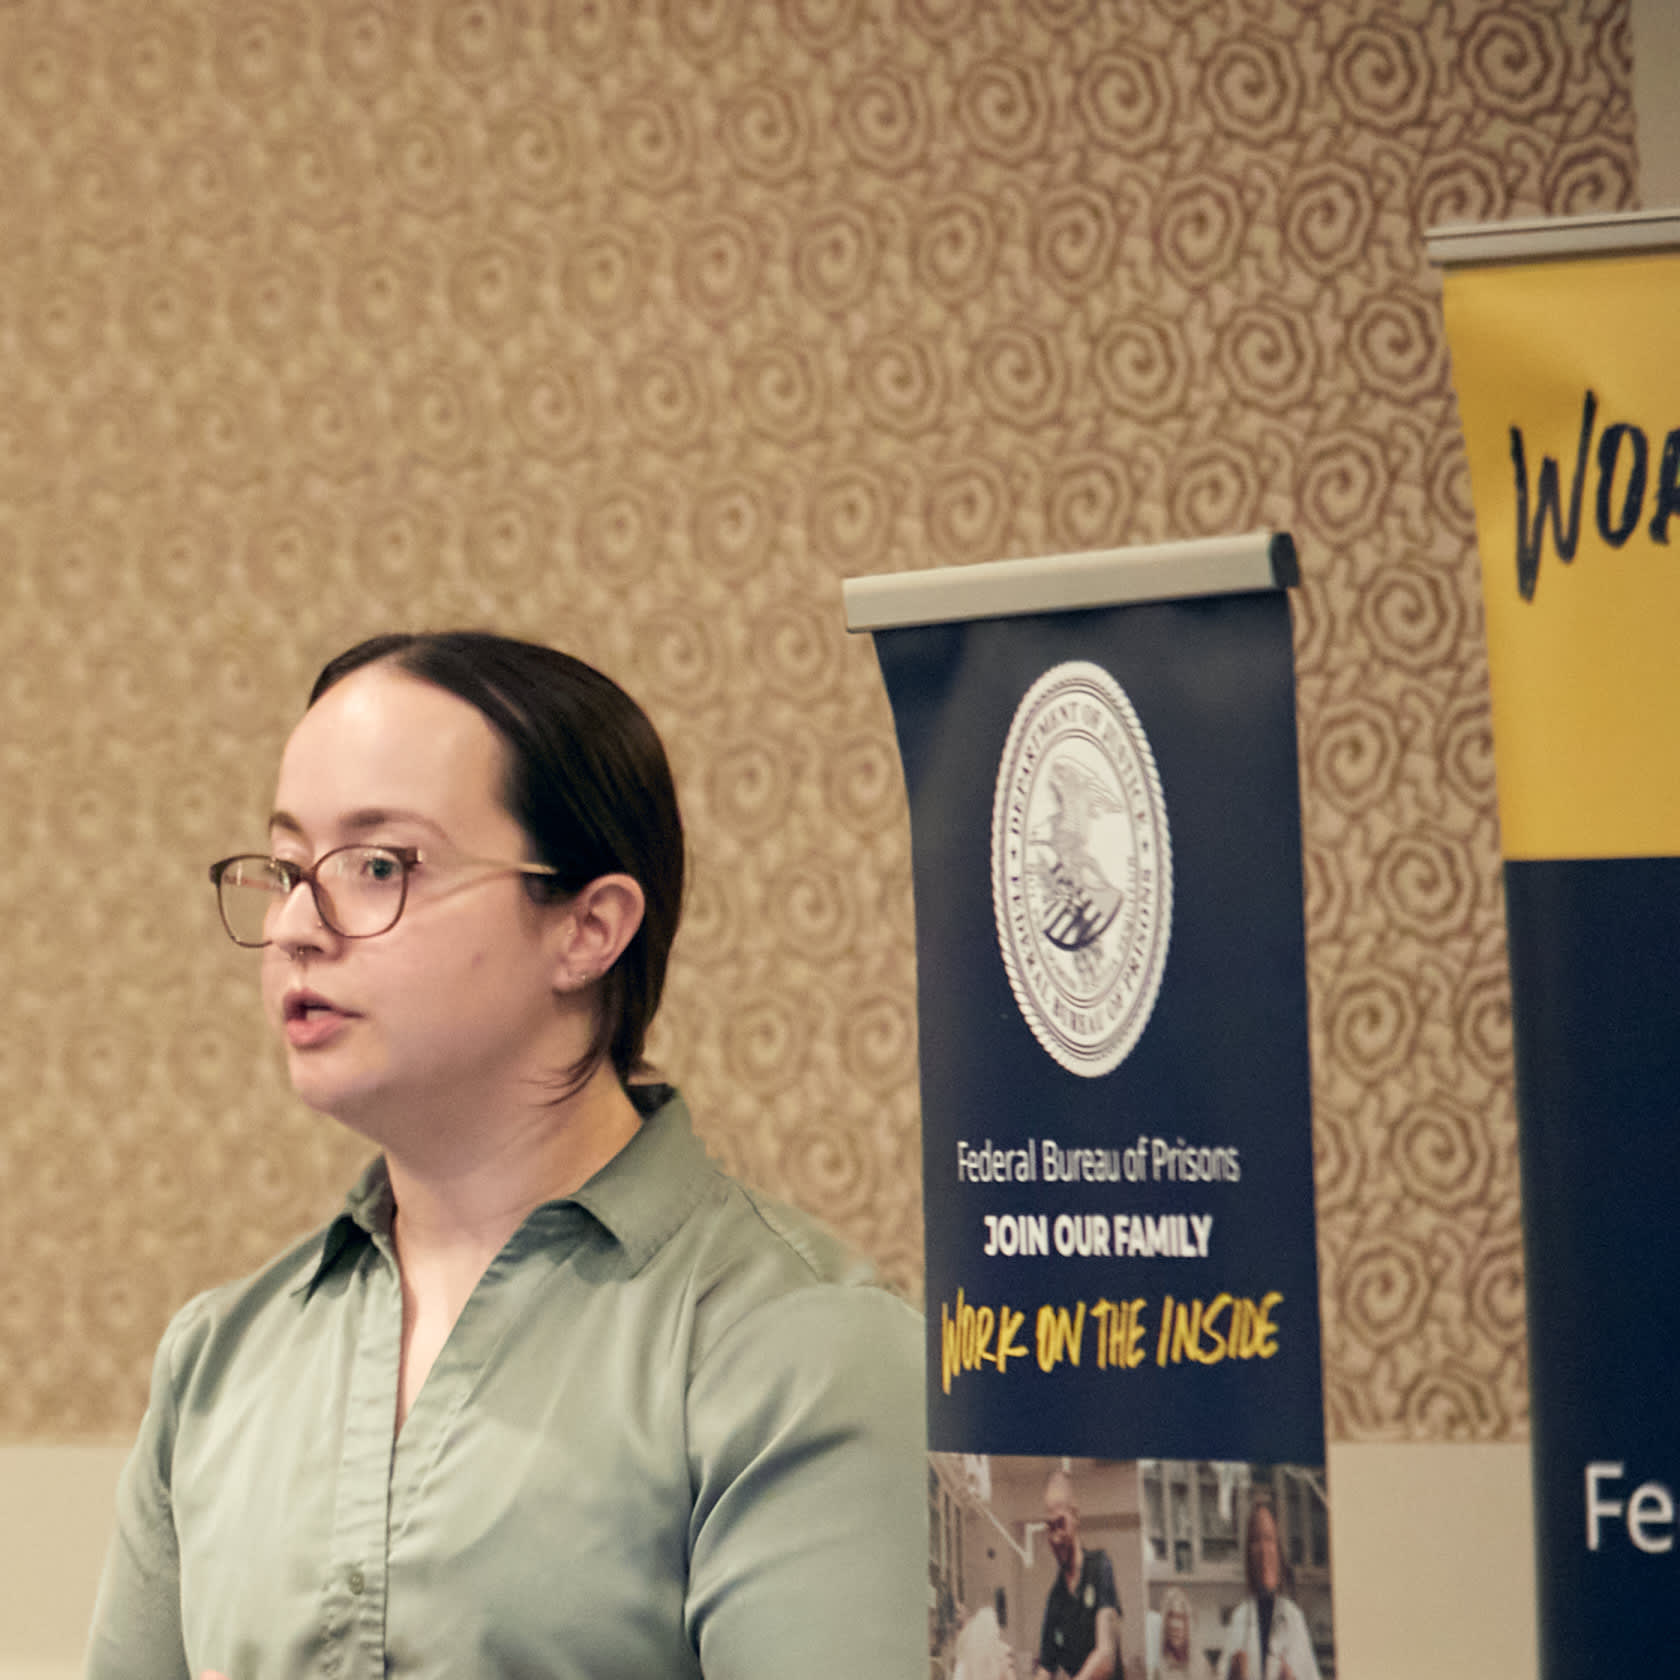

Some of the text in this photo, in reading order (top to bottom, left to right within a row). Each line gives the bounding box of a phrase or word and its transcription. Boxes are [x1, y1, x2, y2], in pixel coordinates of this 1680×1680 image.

[957, 1134, 1241, 1182] Federal Bureau of Prisons
[984, 1214, 1213, 1258] JOIN OUR FAMILY
[942, 1286, 1284, 1395] WORK ON THE INSIDE
